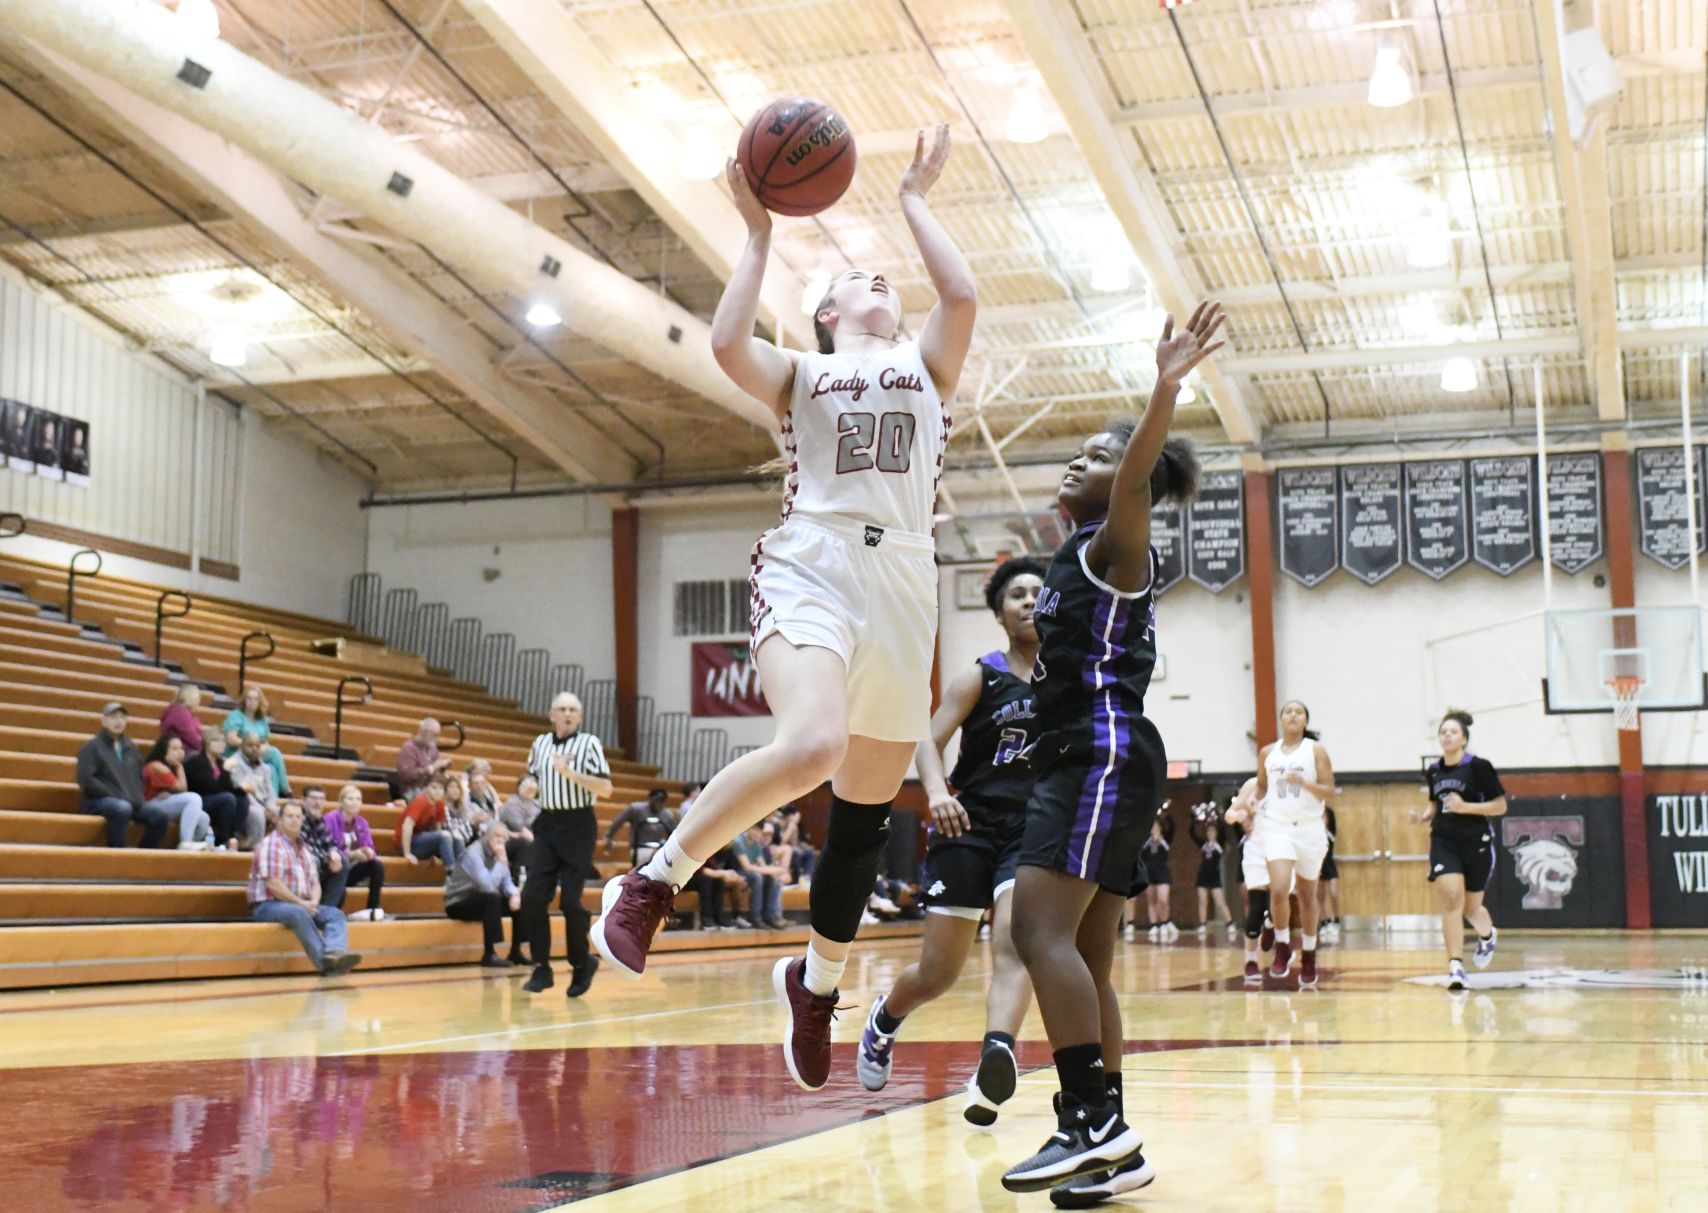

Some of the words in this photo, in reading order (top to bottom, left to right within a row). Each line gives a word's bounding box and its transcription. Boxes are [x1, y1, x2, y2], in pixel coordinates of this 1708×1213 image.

[811, 369, 869, 401] Lady
[879, 367, 923, 393] Cats
[836, 411, 916, 475] 20
